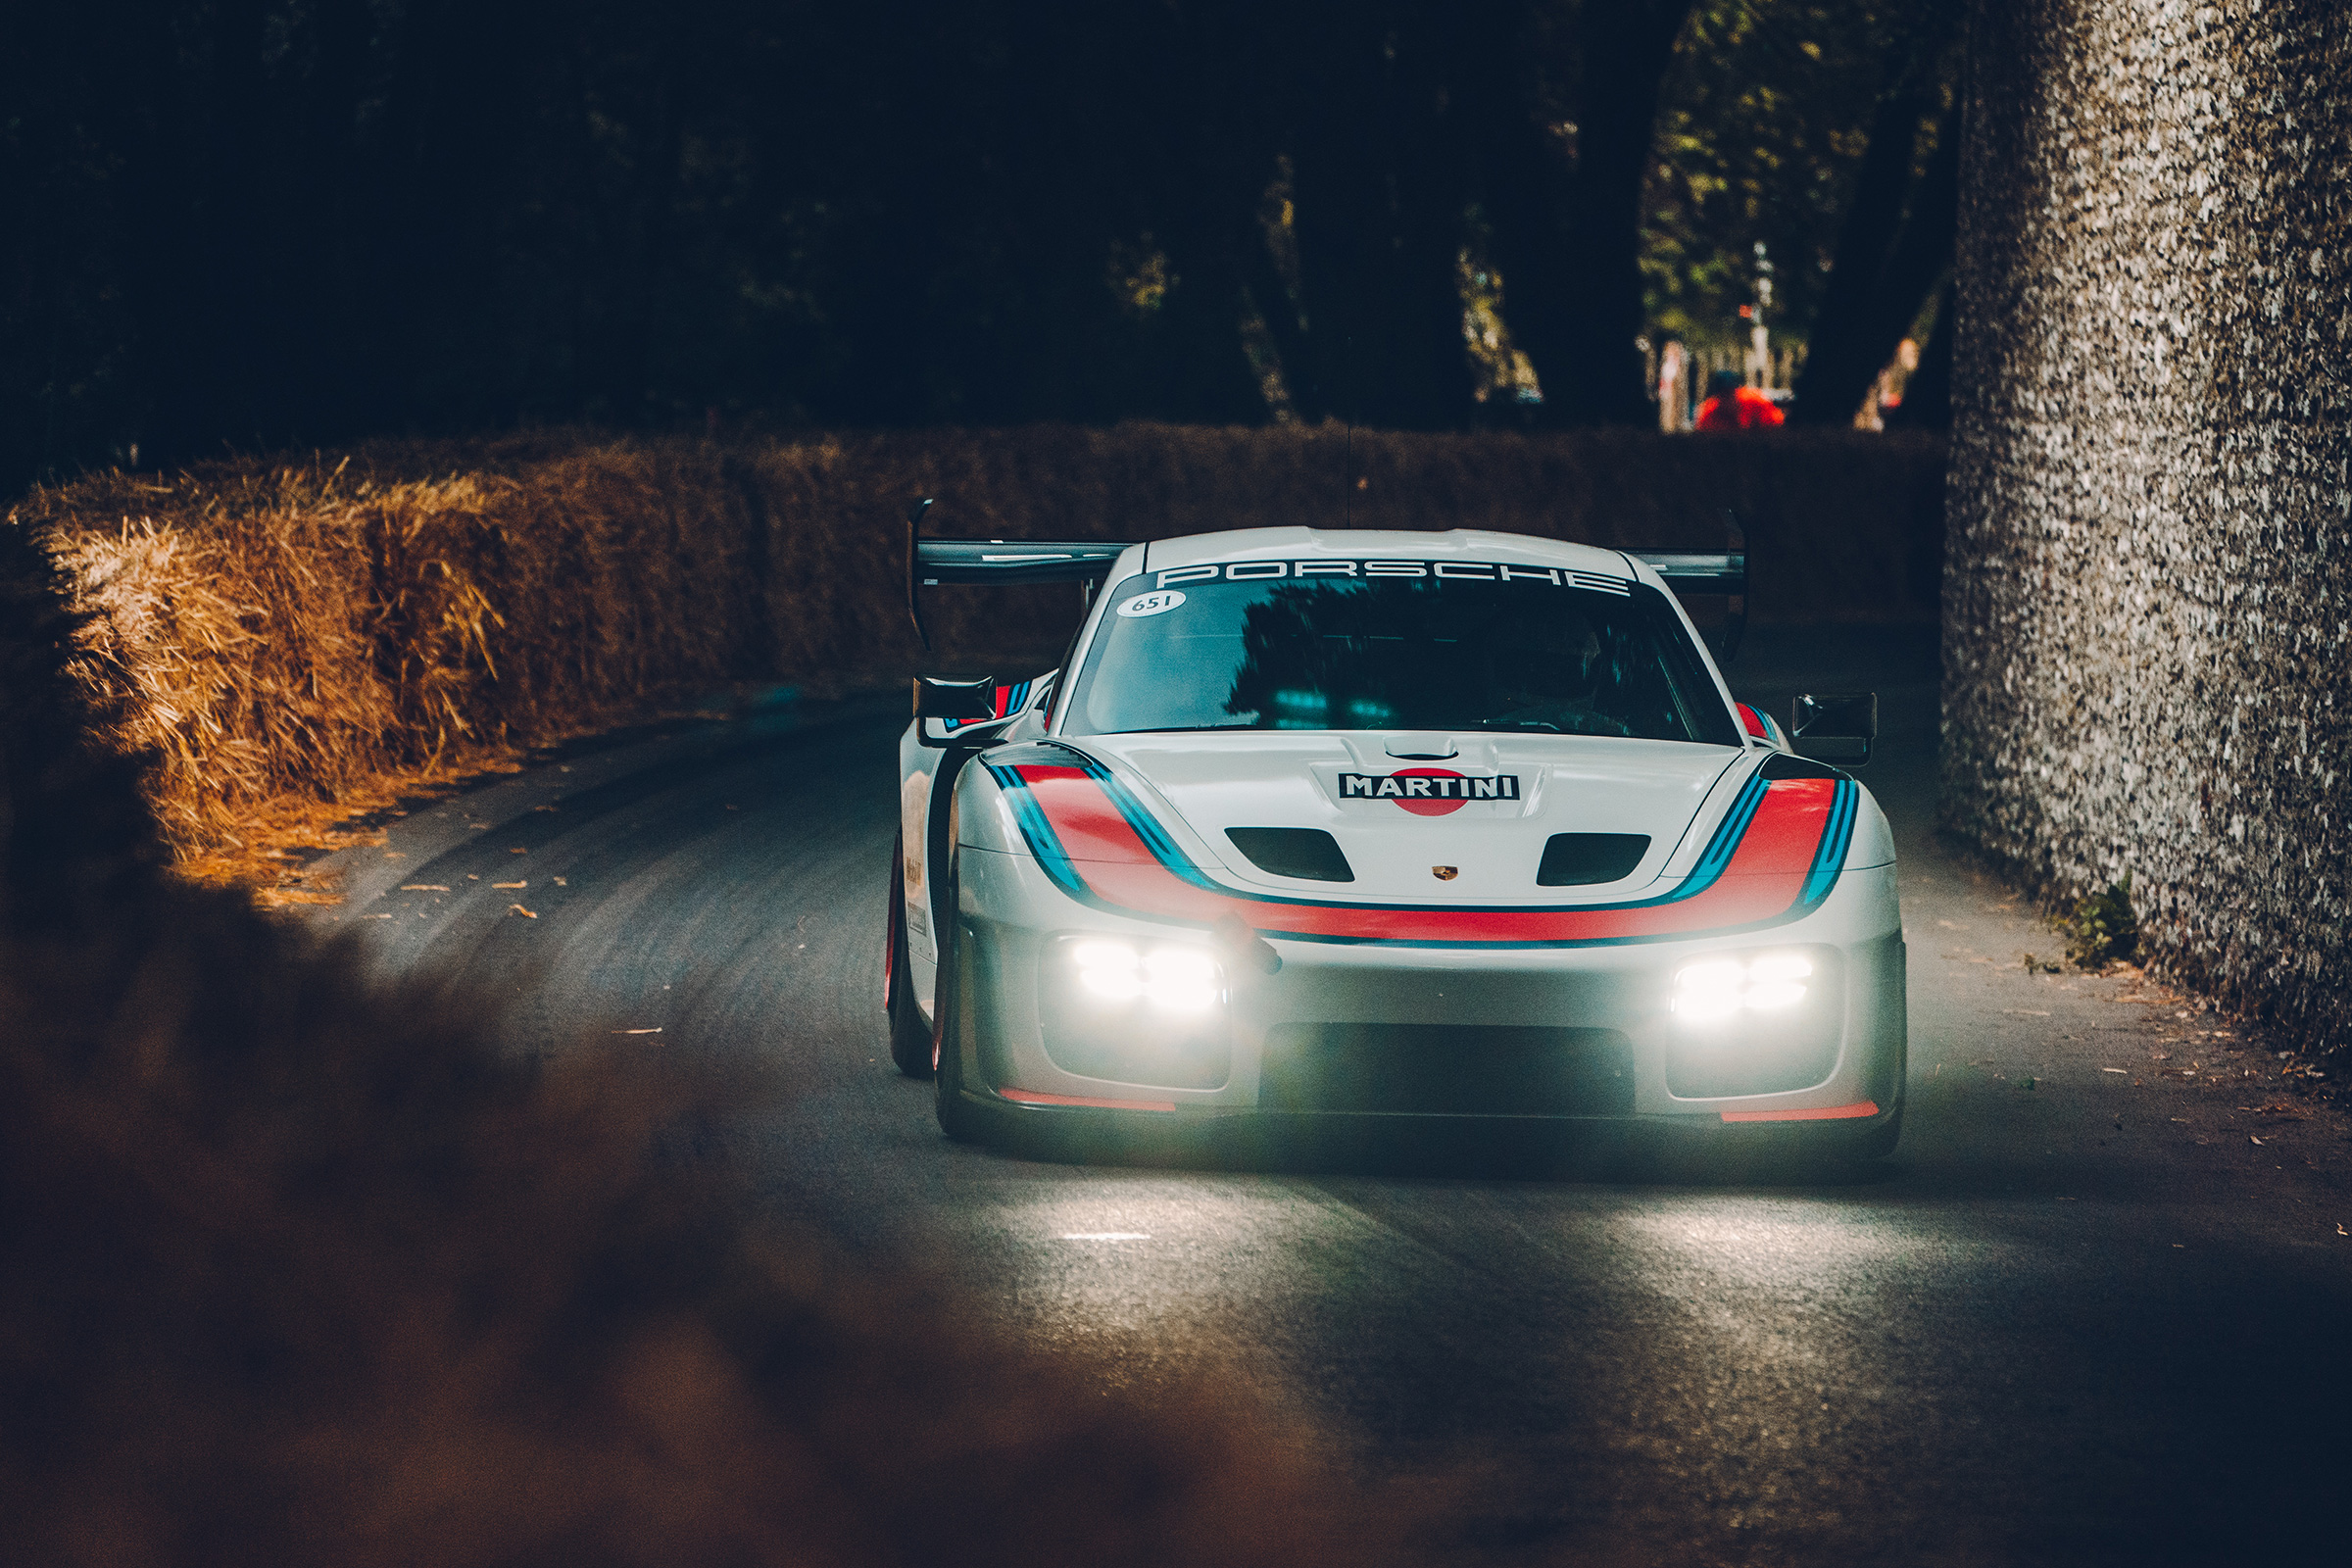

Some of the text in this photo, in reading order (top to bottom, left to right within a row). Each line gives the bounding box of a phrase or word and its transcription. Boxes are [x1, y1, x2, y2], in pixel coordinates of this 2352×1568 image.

[1156, 561, 1631, 597] PORSCHE
[1131, 595, 1171, 612] 651
[1346, 775, 1513, 798] MARTINI
